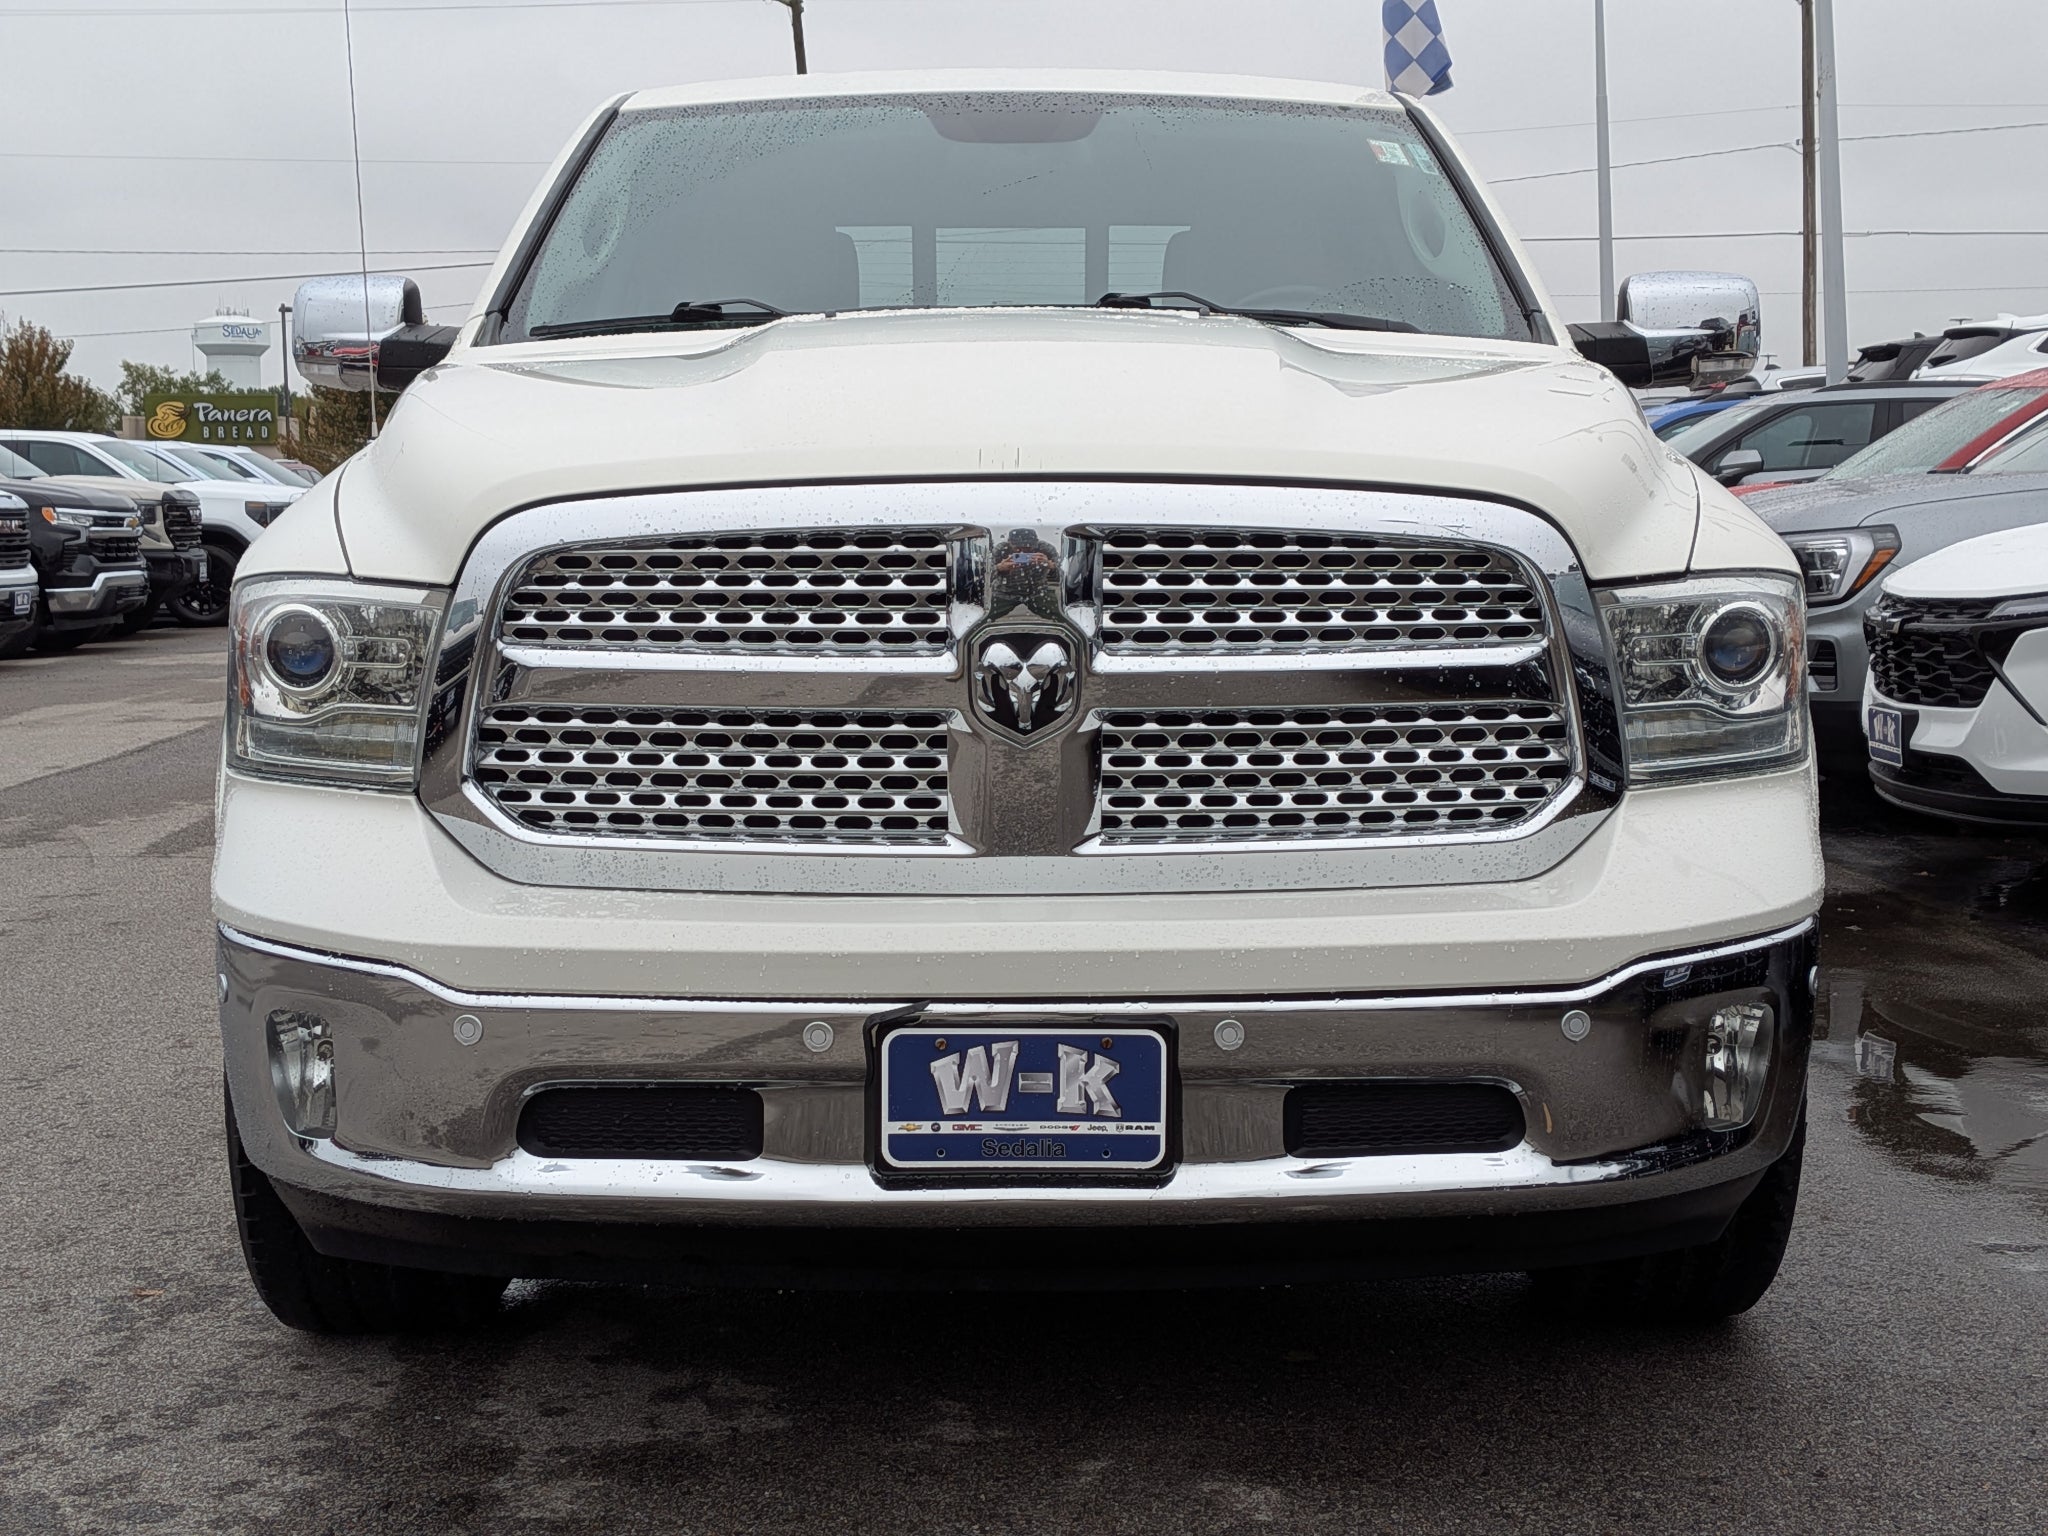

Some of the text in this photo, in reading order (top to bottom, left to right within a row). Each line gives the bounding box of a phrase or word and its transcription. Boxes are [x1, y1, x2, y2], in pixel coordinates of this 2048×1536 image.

[193, 403, 272, 422] Panera
[203, 426, 268, 439] BREAD
[930, 1040, 1122, 1118] W-K
[981, 1138, 1066, 1158] Sedalia
